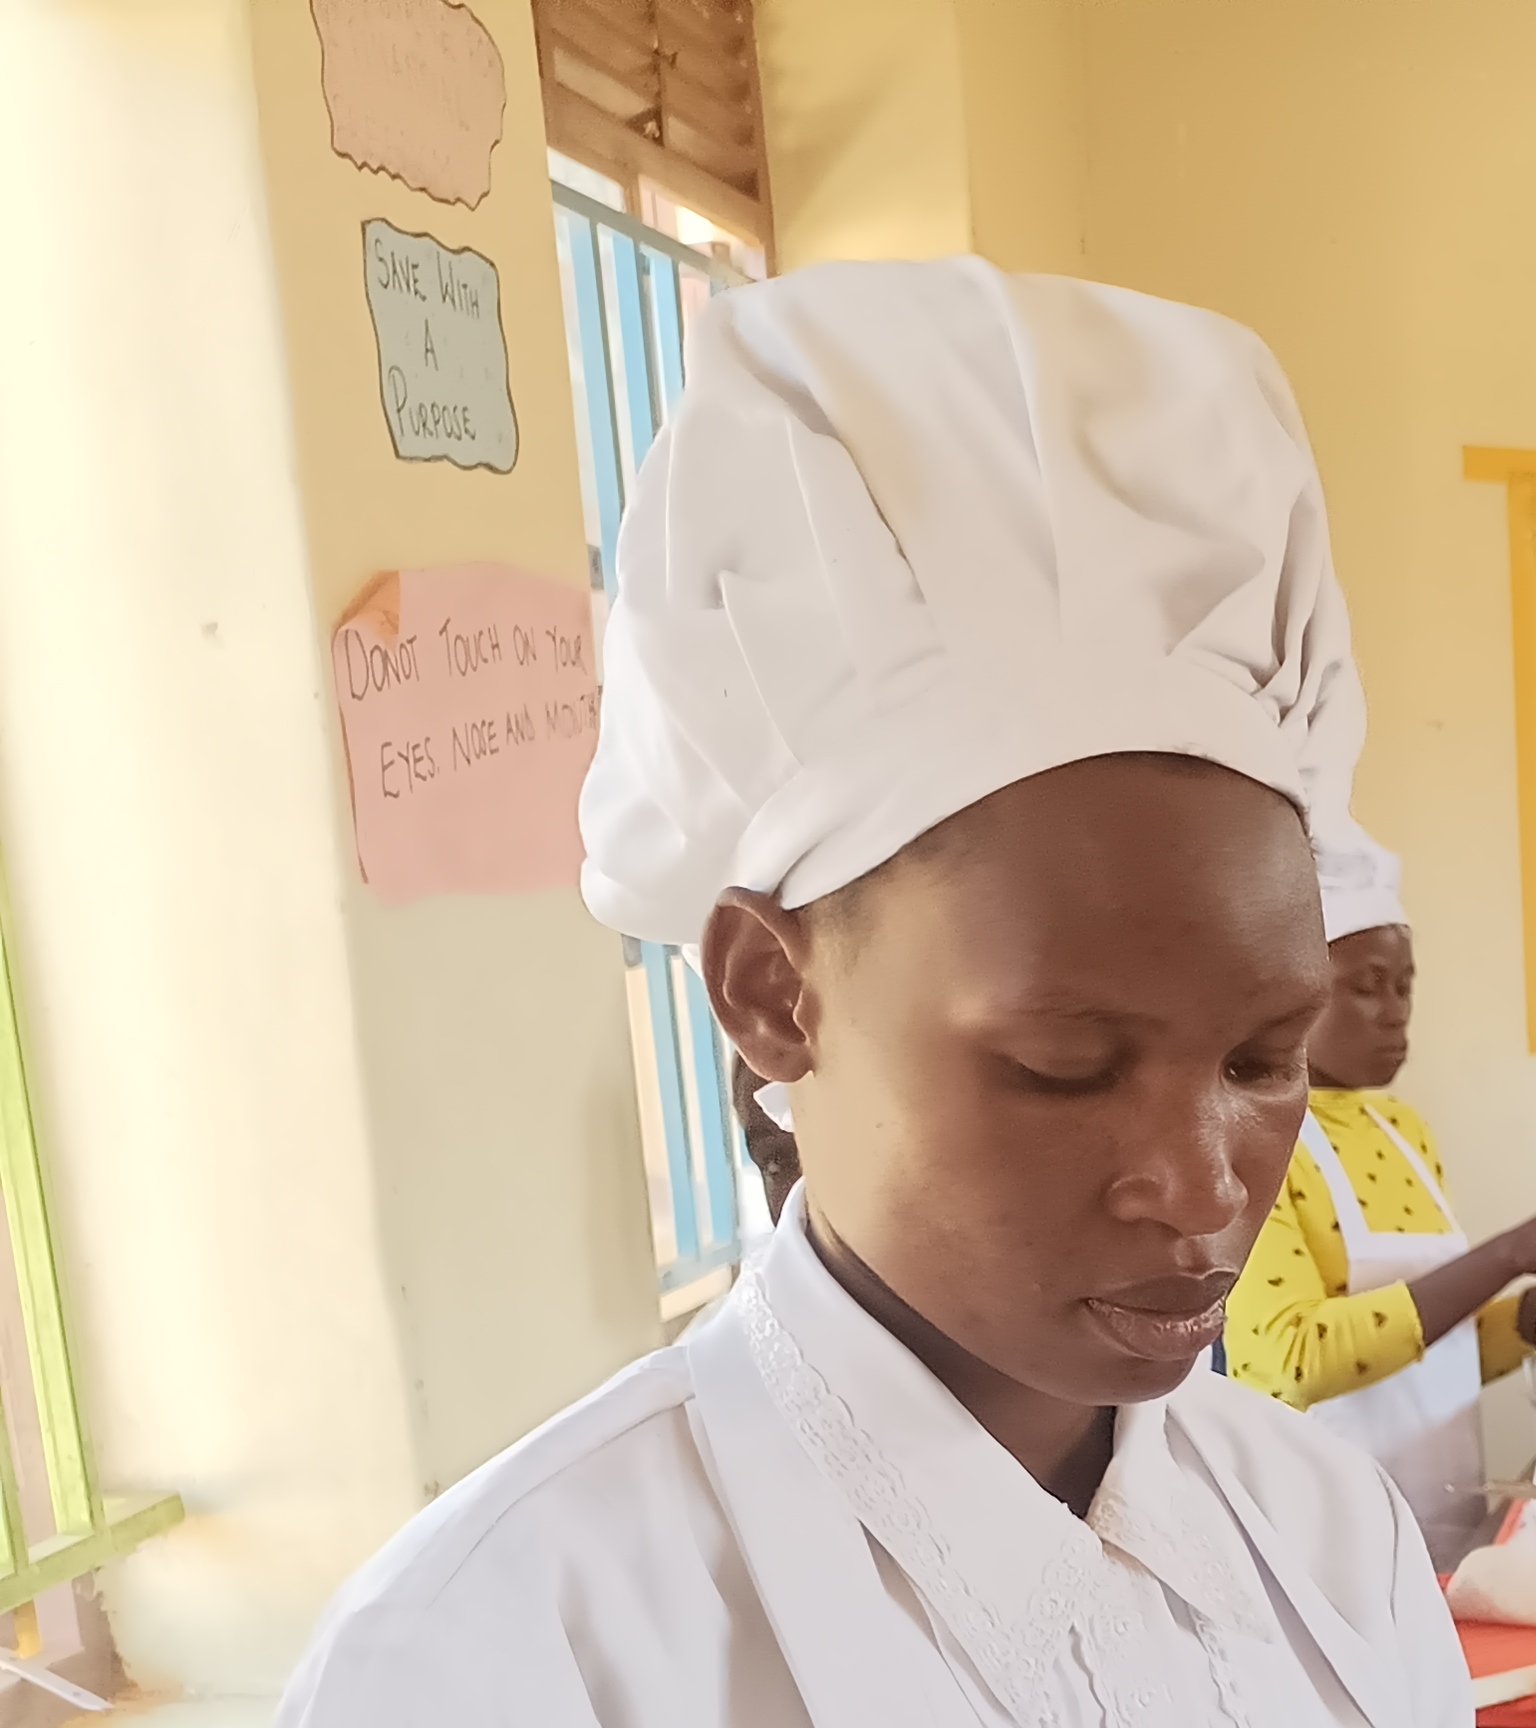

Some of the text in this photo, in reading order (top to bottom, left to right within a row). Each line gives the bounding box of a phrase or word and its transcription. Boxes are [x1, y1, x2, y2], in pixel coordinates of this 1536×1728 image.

[374, 238, 481, 320] SAVE WITH
[423, 320, 438, 371] A
[387, 366, 476, 441] PURPOSE
[439, 618, 502, 677] TOUCH
[513, 625, 538, 666] ON
[546, 626, 588, 674] YOUR
[452, 720, 499, 771] NOSE
[506, 704, 535, 745] AND
